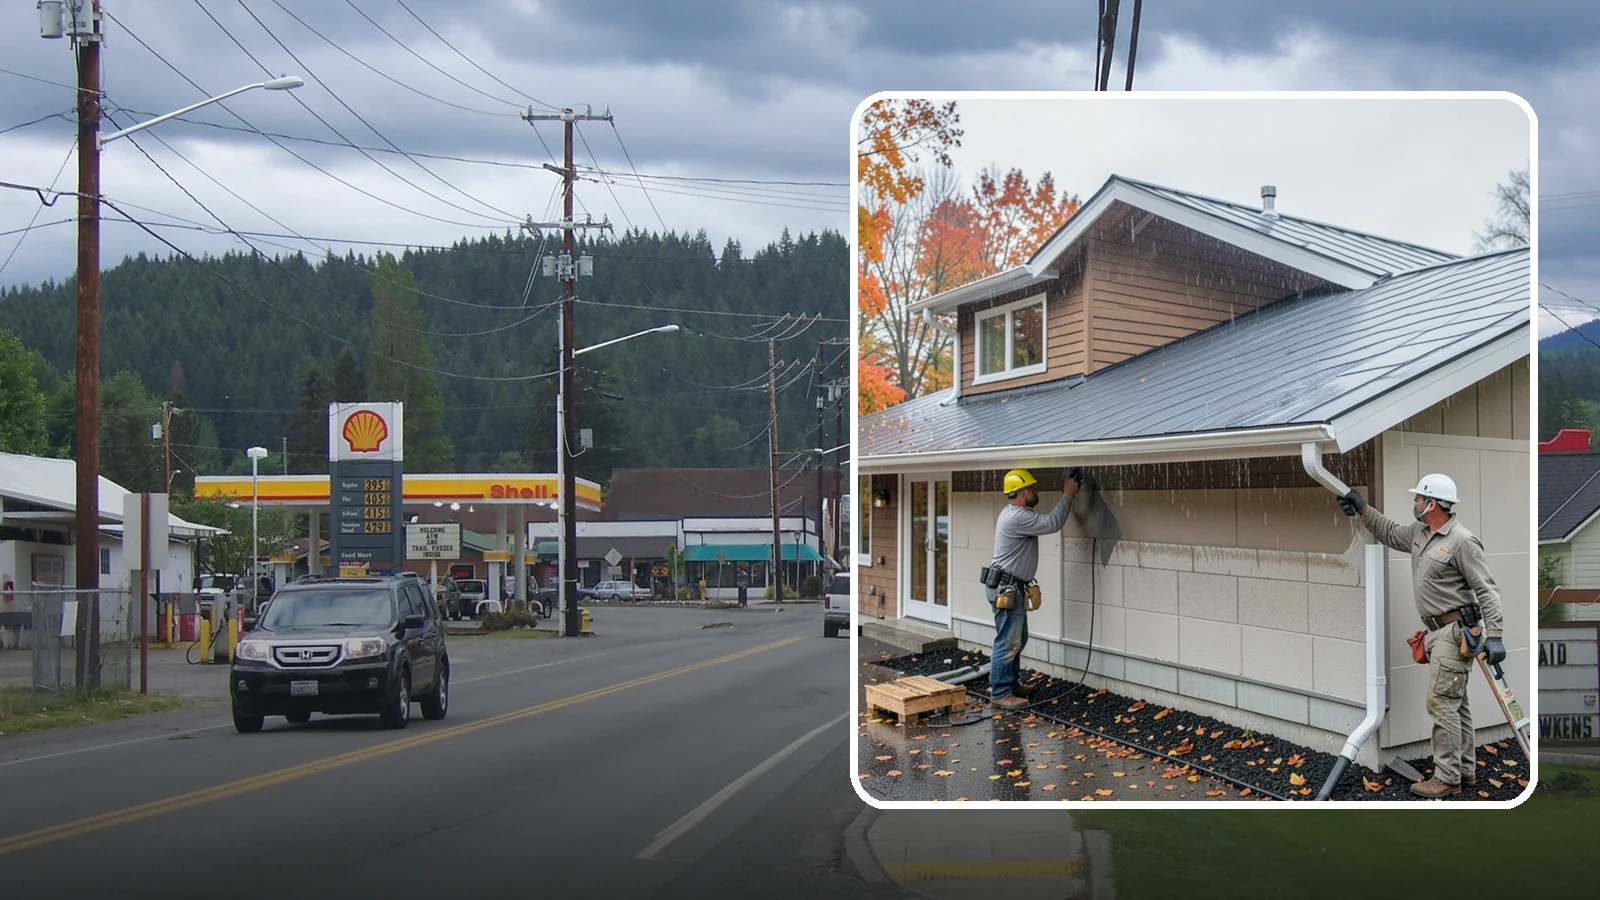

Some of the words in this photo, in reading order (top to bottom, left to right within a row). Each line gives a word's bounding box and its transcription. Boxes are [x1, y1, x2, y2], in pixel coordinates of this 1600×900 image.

[366, 480, 383, 490] 395
[490, 484, 547, 499] Shell
[366, 494, 383, 504] 405
[366, 508, 383, 518] 415
[366, 522, 383, 532] 429
